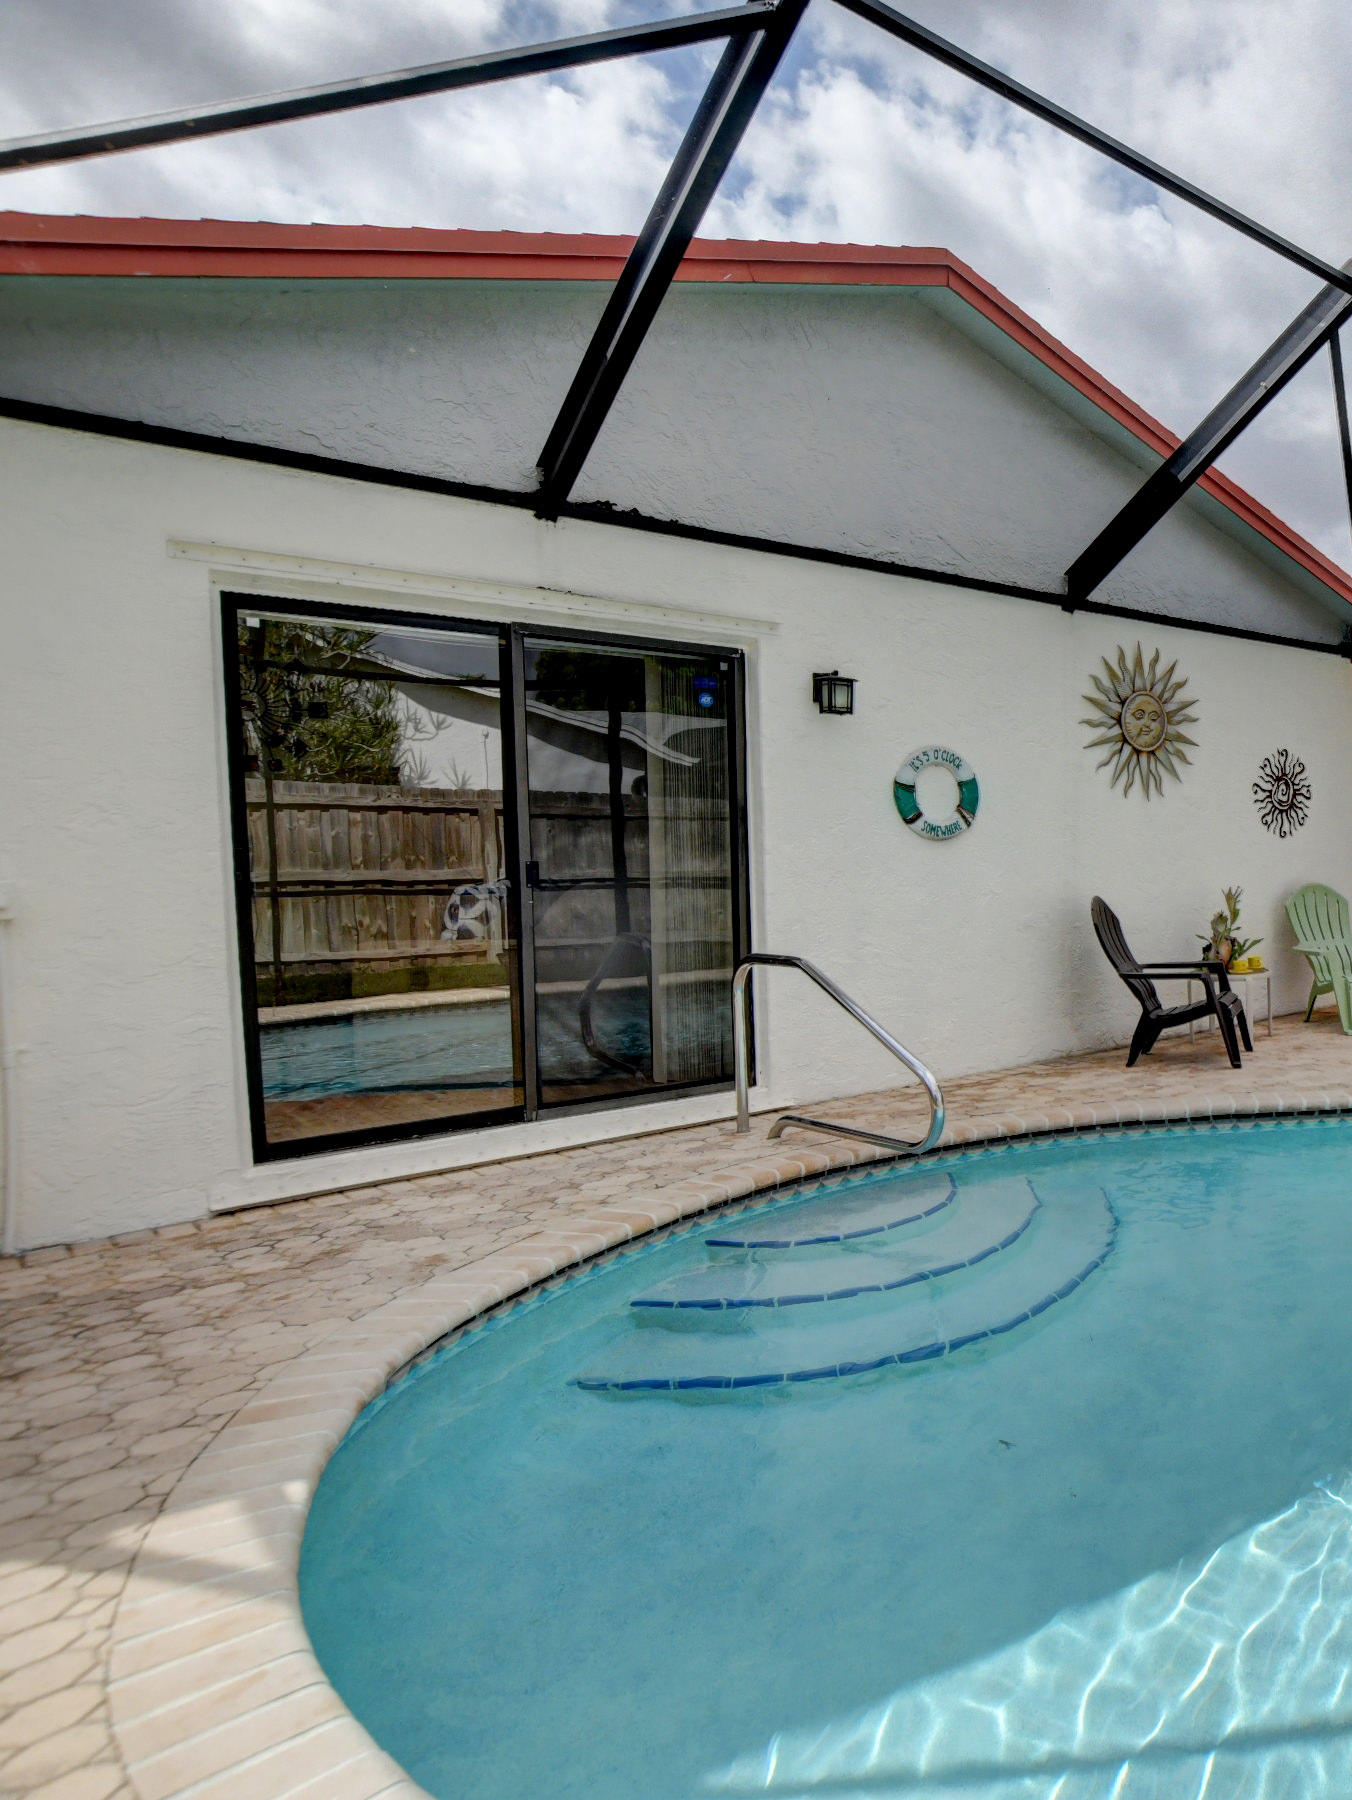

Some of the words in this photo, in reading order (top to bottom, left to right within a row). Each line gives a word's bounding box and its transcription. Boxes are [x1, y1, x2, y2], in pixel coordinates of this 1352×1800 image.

[922, 750, 930, 762] 5
[933, 748, 963, 770] O'CLOCK
[921, 820, 962, 837] SOMEWHERE
